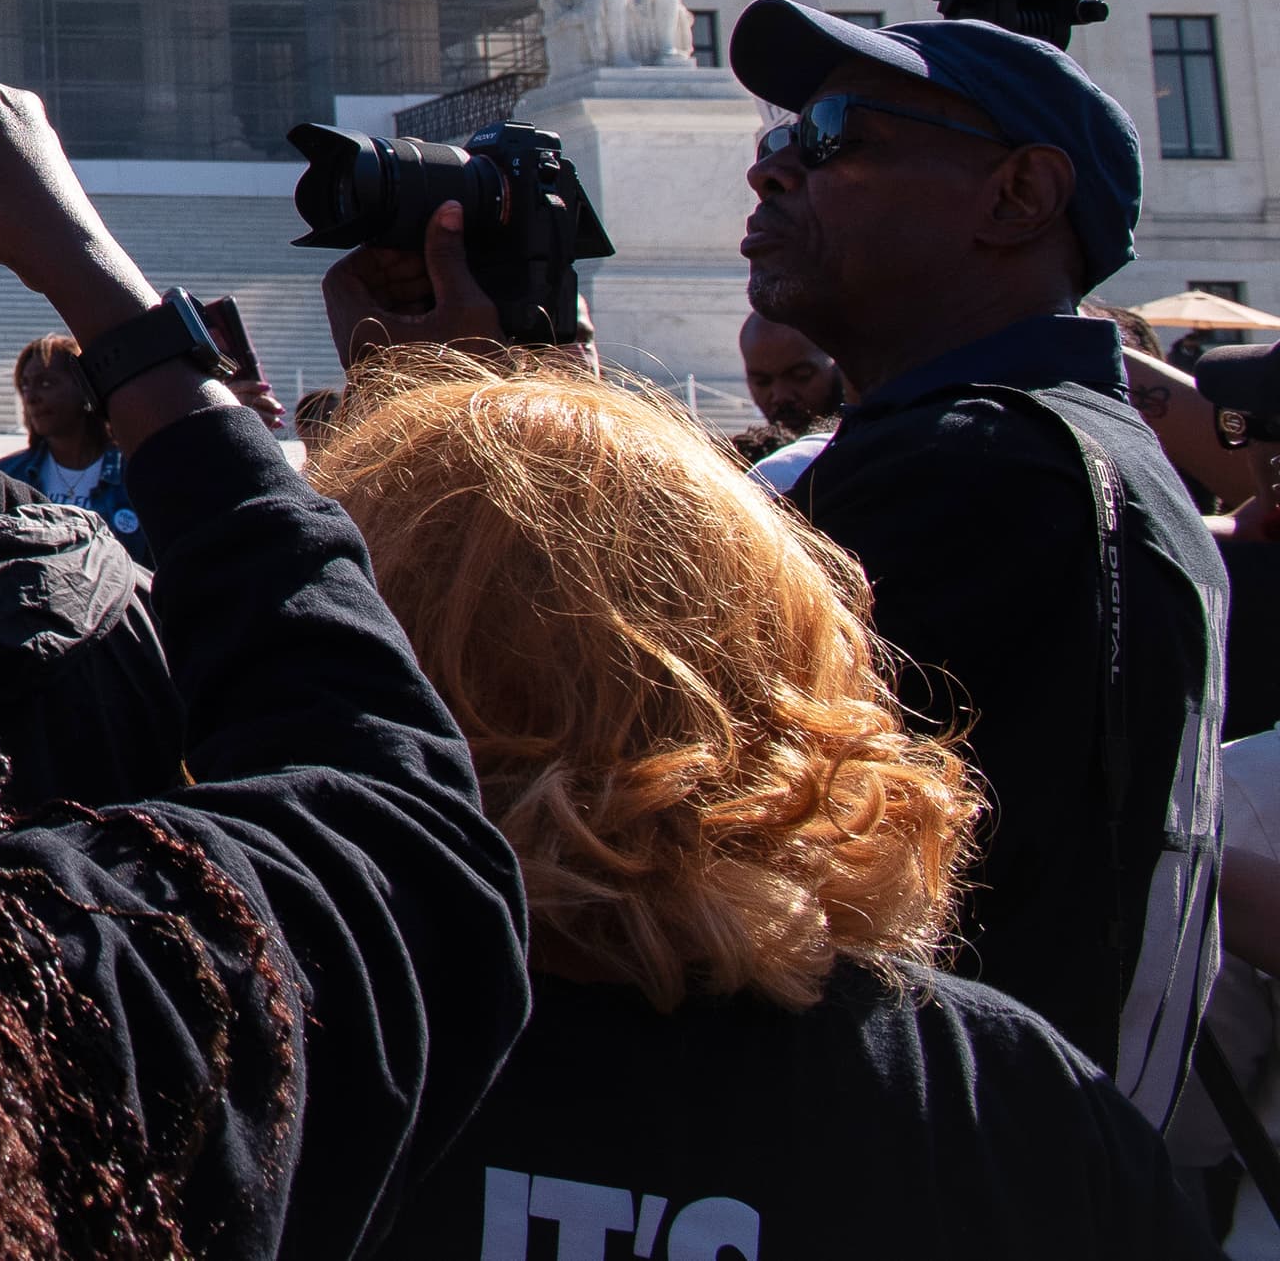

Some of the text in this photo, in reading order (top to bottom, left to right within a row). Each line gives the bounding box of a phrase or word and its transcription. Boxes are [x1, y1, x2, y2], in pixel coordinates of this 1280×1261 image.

[473, 132, 497, 142] SONY
[1095, 459, 1121, 684] EOS DIGITAL
